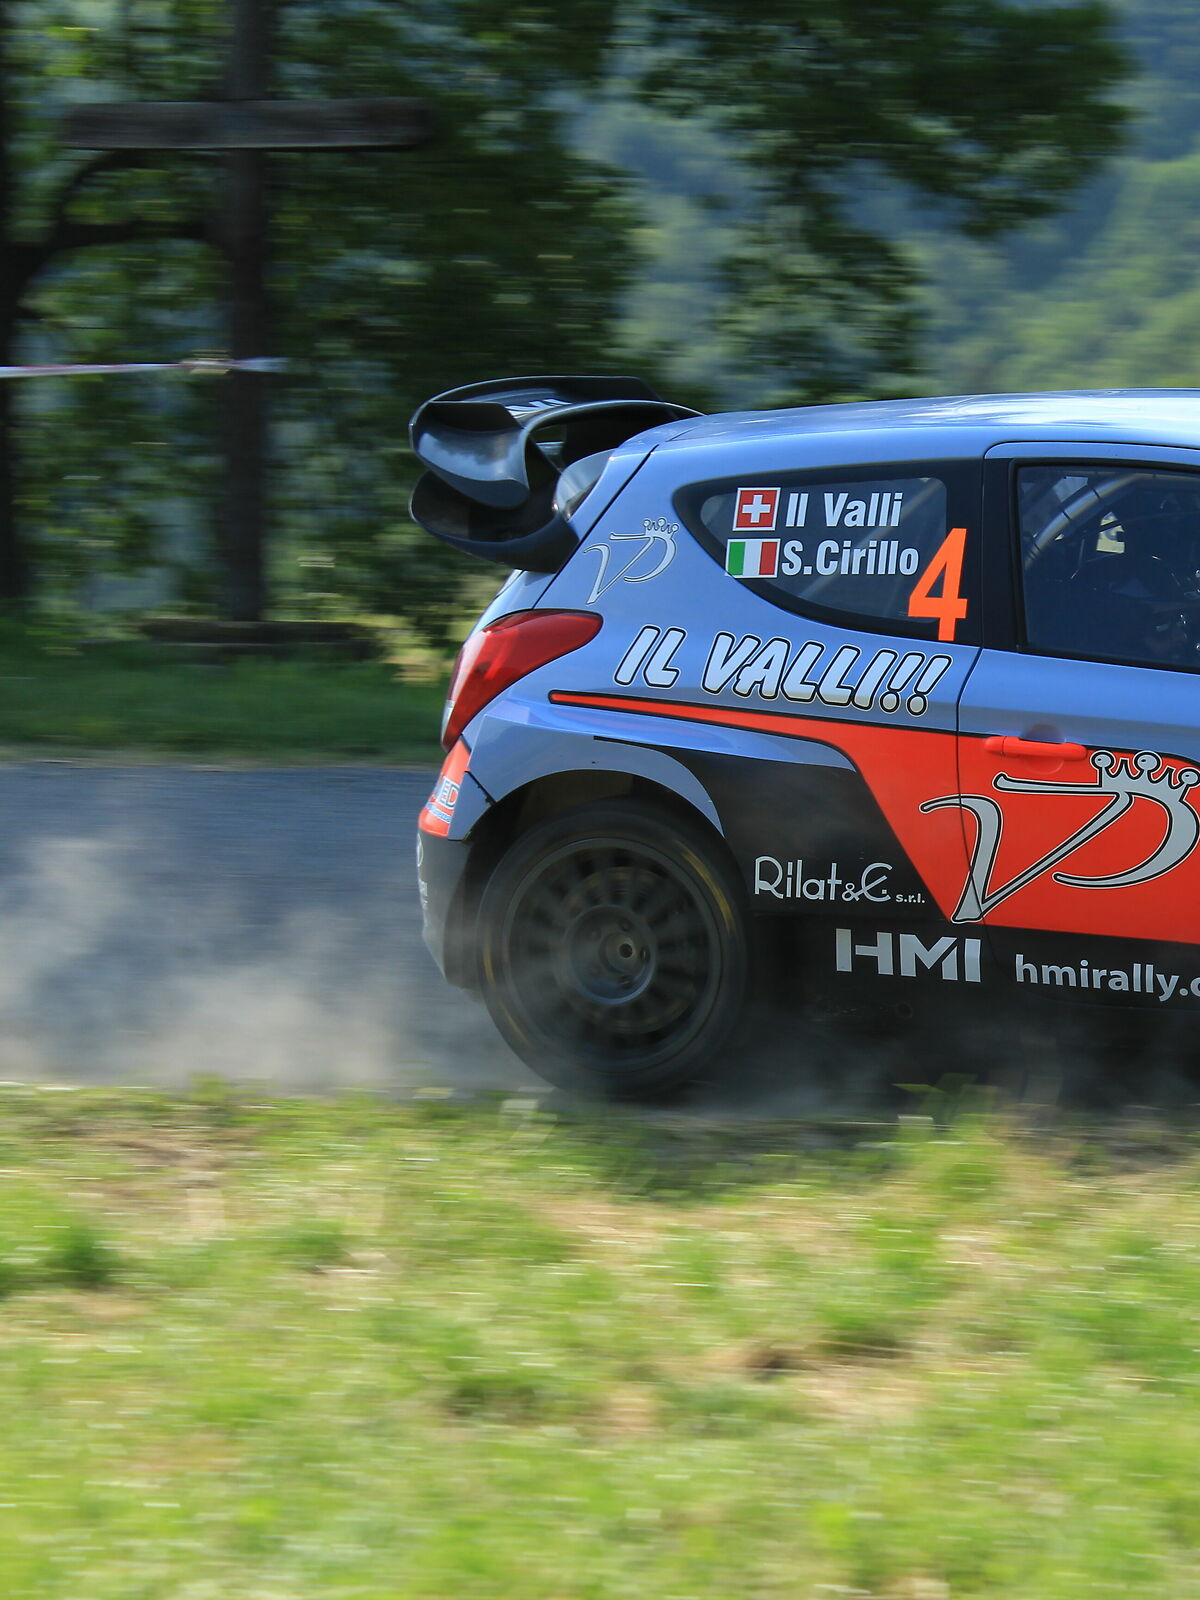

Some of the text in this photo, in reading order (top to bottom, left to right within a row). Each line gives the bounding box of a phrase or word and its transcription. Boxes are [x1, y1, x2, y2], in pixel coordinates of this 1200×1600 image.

[784, 492, 903, 528] Il Valli
[781, 539, 919, 576] S.Cirillo
[906, 527, 968, 641] 4
[613, 625, 687, 689] IL
[895, 892, 926, 904] s.r.l.
[835, 928, 982, 983] HMI
